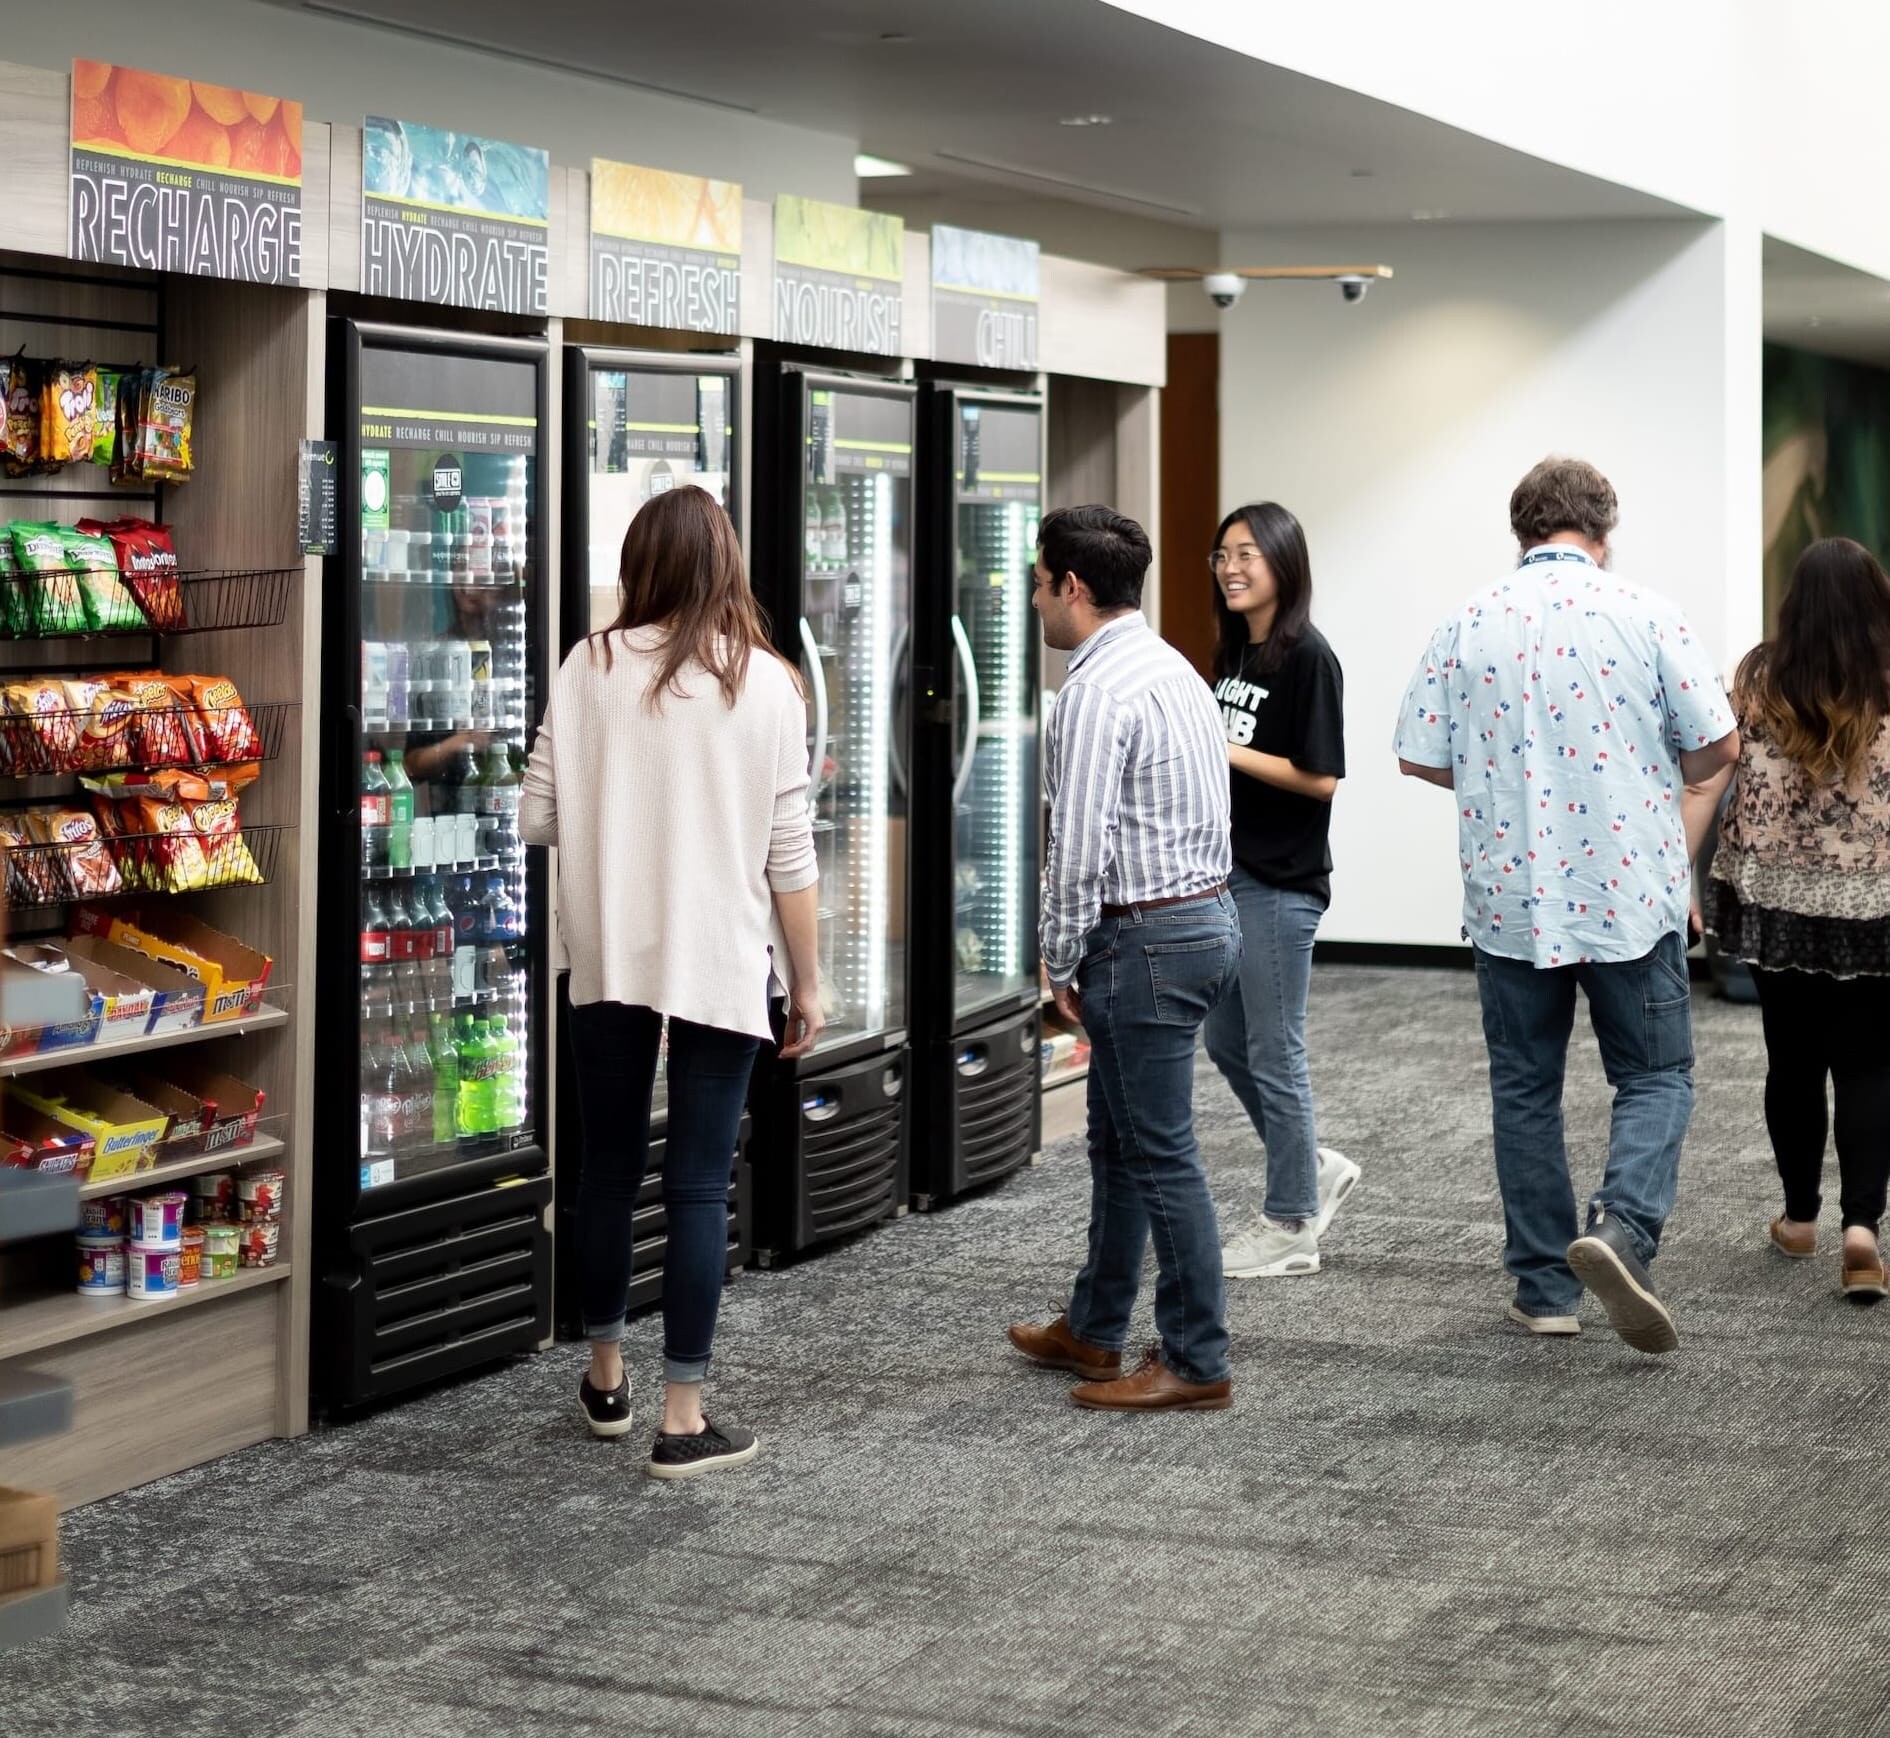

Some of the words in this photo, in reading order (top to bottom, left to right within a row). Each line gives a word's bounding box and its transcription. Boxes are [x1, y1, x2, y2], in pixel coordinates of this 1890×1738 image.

[76, 159, 116, 176] REPLENISH
[120, 164, 152, 181] HYDRATE
[156, 171, 192, 188] RECHARGE
[196, 176, 216, 193] CHILL
[220, 181, 249, 196] NOURISH
[252, 186, 264, 200] SIP
[267, 189, 296, 204] REFRESH
[71, 174, 301, 284] RECHARGE
[402, 211, 427, 225] HYDRATE
[430, 214, 460, 230] RECHARGE
[462, 220, 478, 232] CHILL
[363, 219, 547, 315] HYDRATE
[599, 252, 741, 335] REFRESH
[774, 279, 902, 356] NOURISH
[976, 309, 1039, 370] CHILL
[154, 384, 190, 406] HARIBO
[361, 424, 392, 439] HYDRATE
[396, 426, 431, 441] RECHARGE
[435, 429, 454, 442] CHILL
[458, 430, 486, 444] NOURISH
[490, 432, 500, 446] SIP
[504, 434, 532, 448] REFRESH
[103, 1129, 160, 1154] Butterfinger
